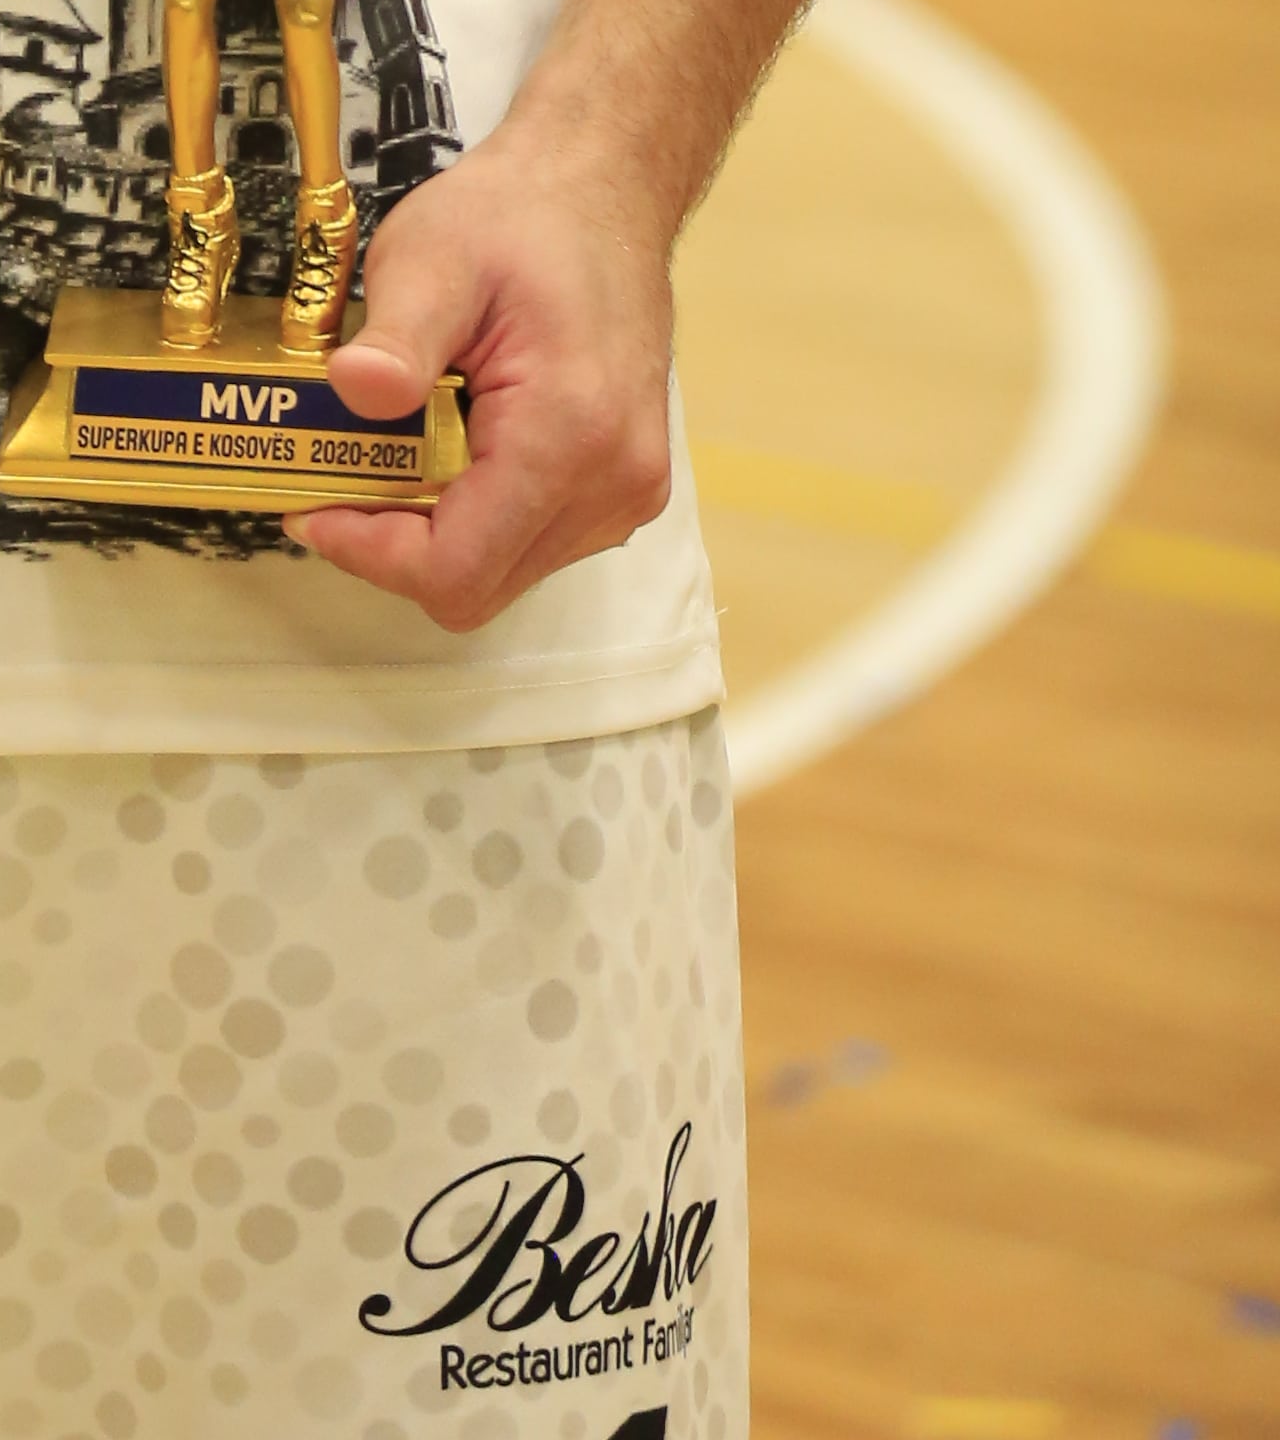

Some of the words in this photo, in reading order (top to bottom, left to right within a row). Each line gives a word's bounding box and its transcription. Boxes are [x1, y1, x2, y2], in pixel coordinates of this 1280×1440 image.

[200, 381, 299, 424] MVP
[77, 424, 188, 455] SUPERKUPA
[192, 432, 204, 456] E
[208, 430, 296, 462] KOSOVËS
[310, 438, 418, 471] 2020-2021
[440, 1326, 634, 1391] Restaurant
